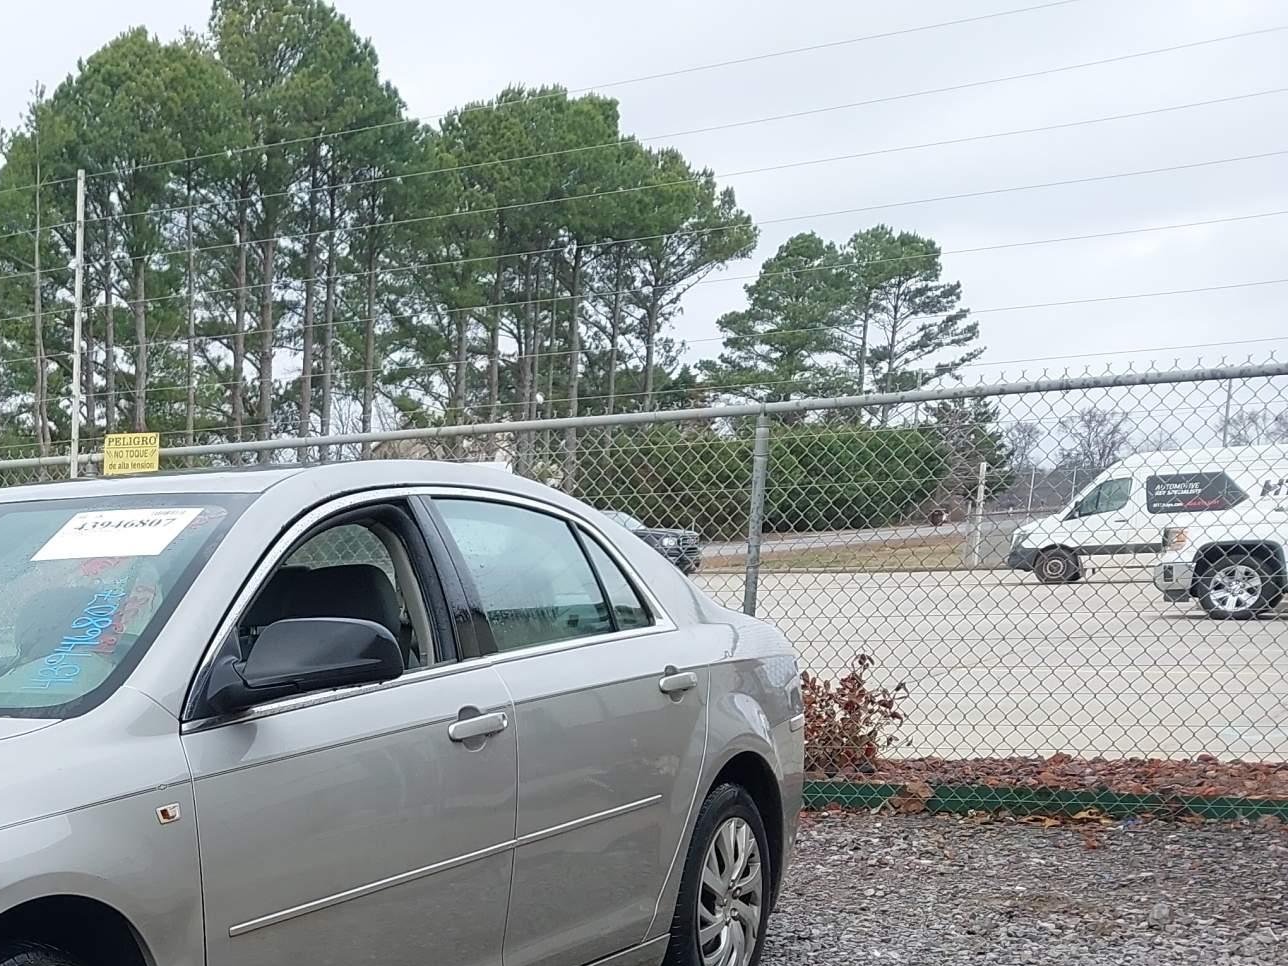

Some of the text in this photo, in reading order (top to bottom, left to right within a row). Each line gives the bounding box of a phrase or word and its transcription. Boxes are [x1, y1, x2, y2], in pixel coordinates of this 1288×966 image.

[108, 436, 157, 446] PELIGRO
[114, 449, 149, 458] NO TOQUE
[73, 518, 176, 531] 43946807
